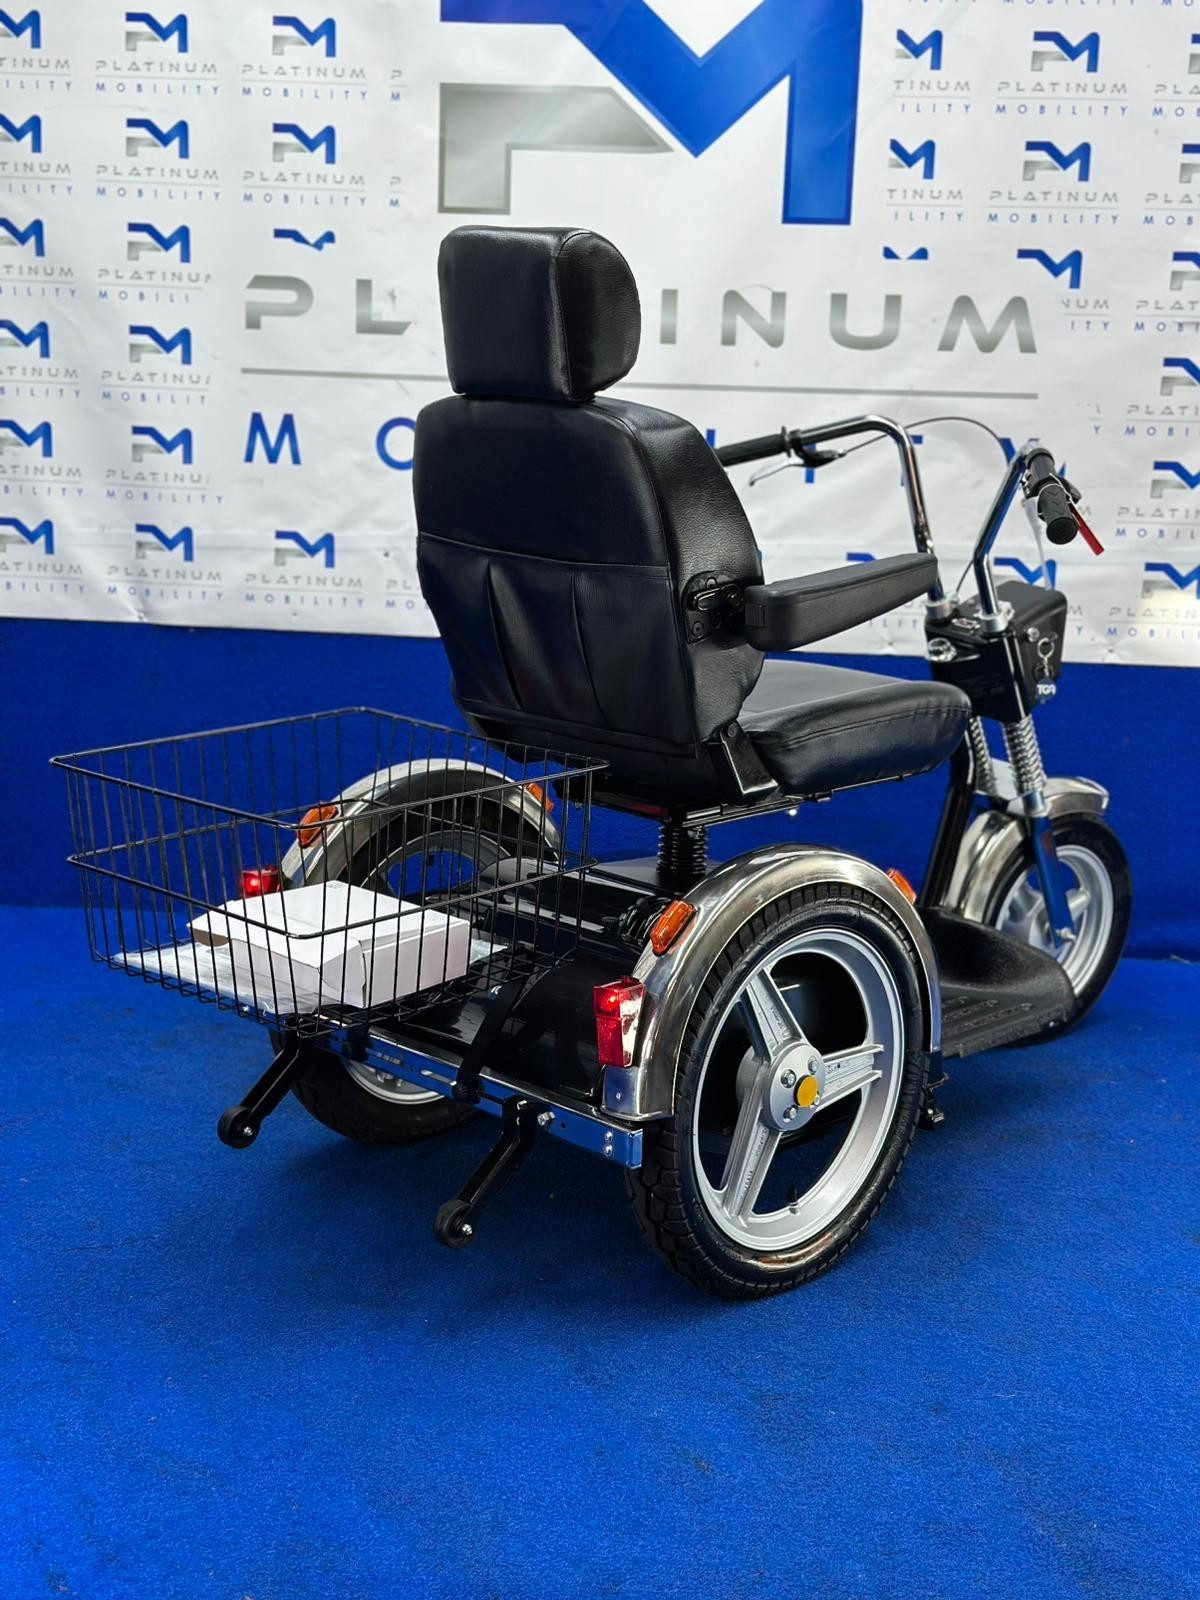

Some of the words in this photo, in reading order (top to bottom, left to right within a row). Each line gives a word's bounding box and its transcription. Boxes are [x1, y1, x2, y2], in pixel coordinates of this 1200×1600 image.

[96, 60, 218, 74] PLATINUM
[241, 64, 366, 79] PLATINUM
[96, 82, 219, 96] MOBILITY
[242, 86, 367, 100] MOBILITY
[997, 81, 1127, 94] PLATINUM
[996, 104, 1127, 115] MOBILITY
[96, 165, 218, 180] PLATINUM
[243, 170, 365, 185] PLATINUM
[97, 187, 219, 201] MOBILITY
[243, 193, 366, 207] MOBILITY
[989, 190, 1119, 203] PLATINUM
[1145, 193, 1200, 204] PLA
[988, 212, 1119, 224] MOBILITY
[98, 290, 189, 303] MOBILI
[245, 274, 1037, 354] PLINUM
[0, 366, 78, 378] TINUM
[101, 370, 210, 385] PLATINU
[102, 392, 205, 405] MOBILIT
[105, 469, 209, 484] PLATINU
[106, 489, 223, 504] MOBILITY
[107, 565, 222, 581] PLATINUM
[245, 573, 363, 588] PLATINUM
[107, 585, 223, 600] MOBILITY
[245, 593, 364, 607] MOBILITY
